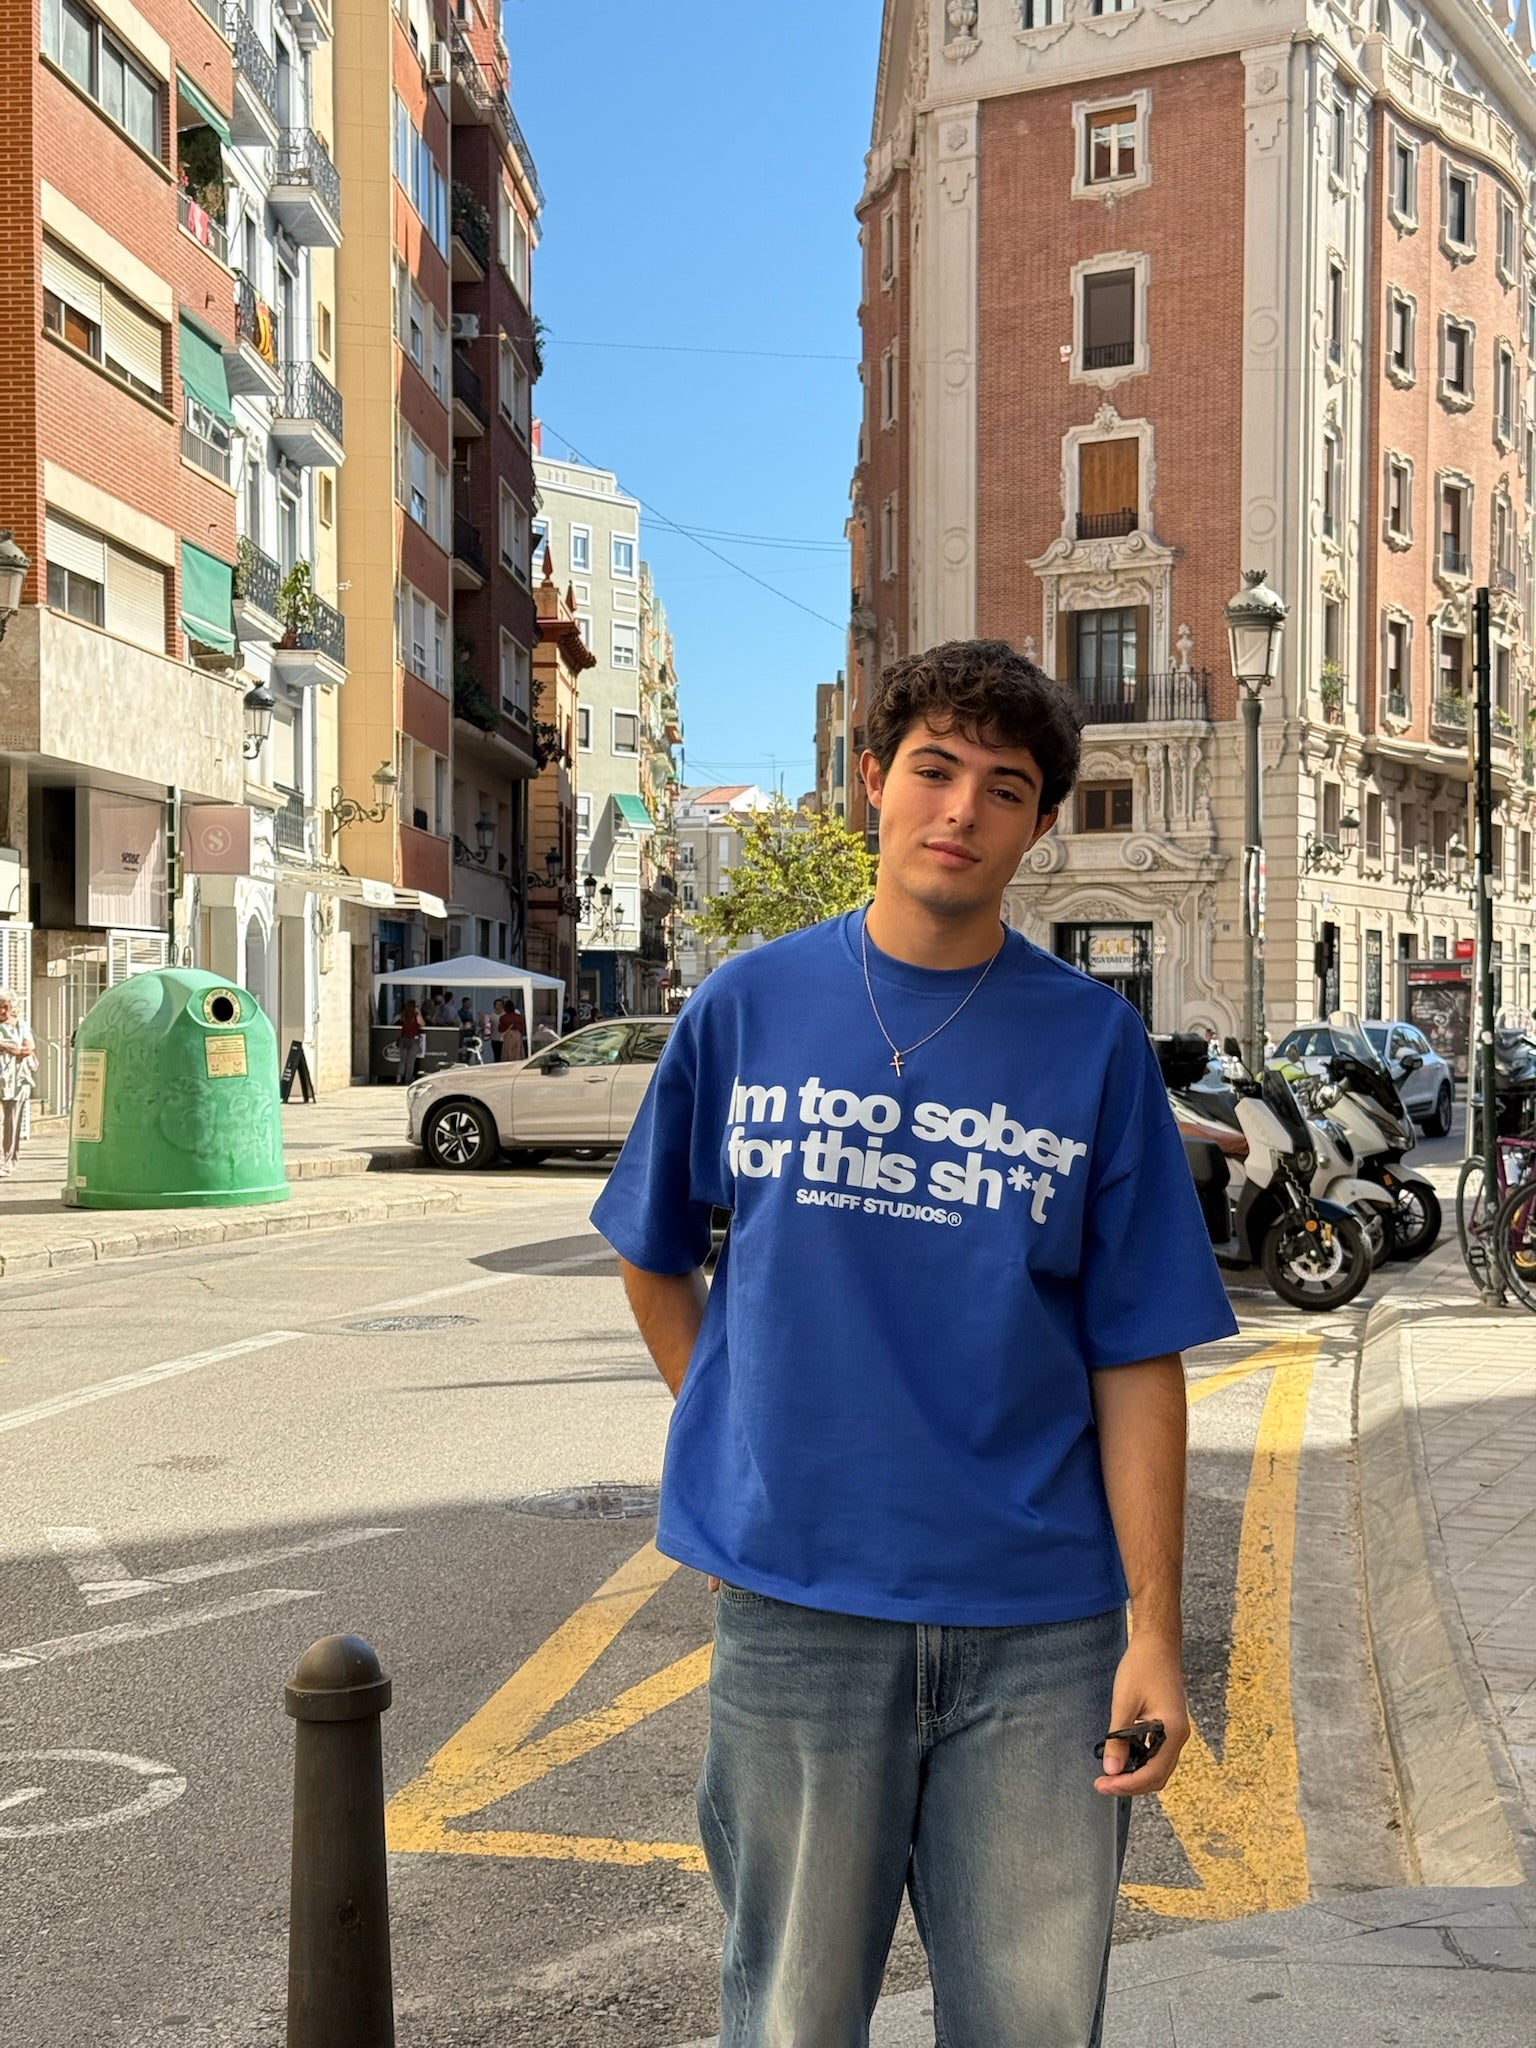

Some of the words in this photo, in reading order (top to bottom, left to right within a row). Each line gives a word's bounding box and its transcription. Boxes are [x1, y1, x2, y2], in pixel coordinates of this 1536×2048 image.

[727, 1075, 787, 1125] Im
[798, 1077, 901, 1134] too
[912, 1102, 1087, 1176] sober
[728, 1126, 792, 1178] for
[800, 1130, 917, 1194] this
[796, 1188, 861, 1210] SAKIFF
